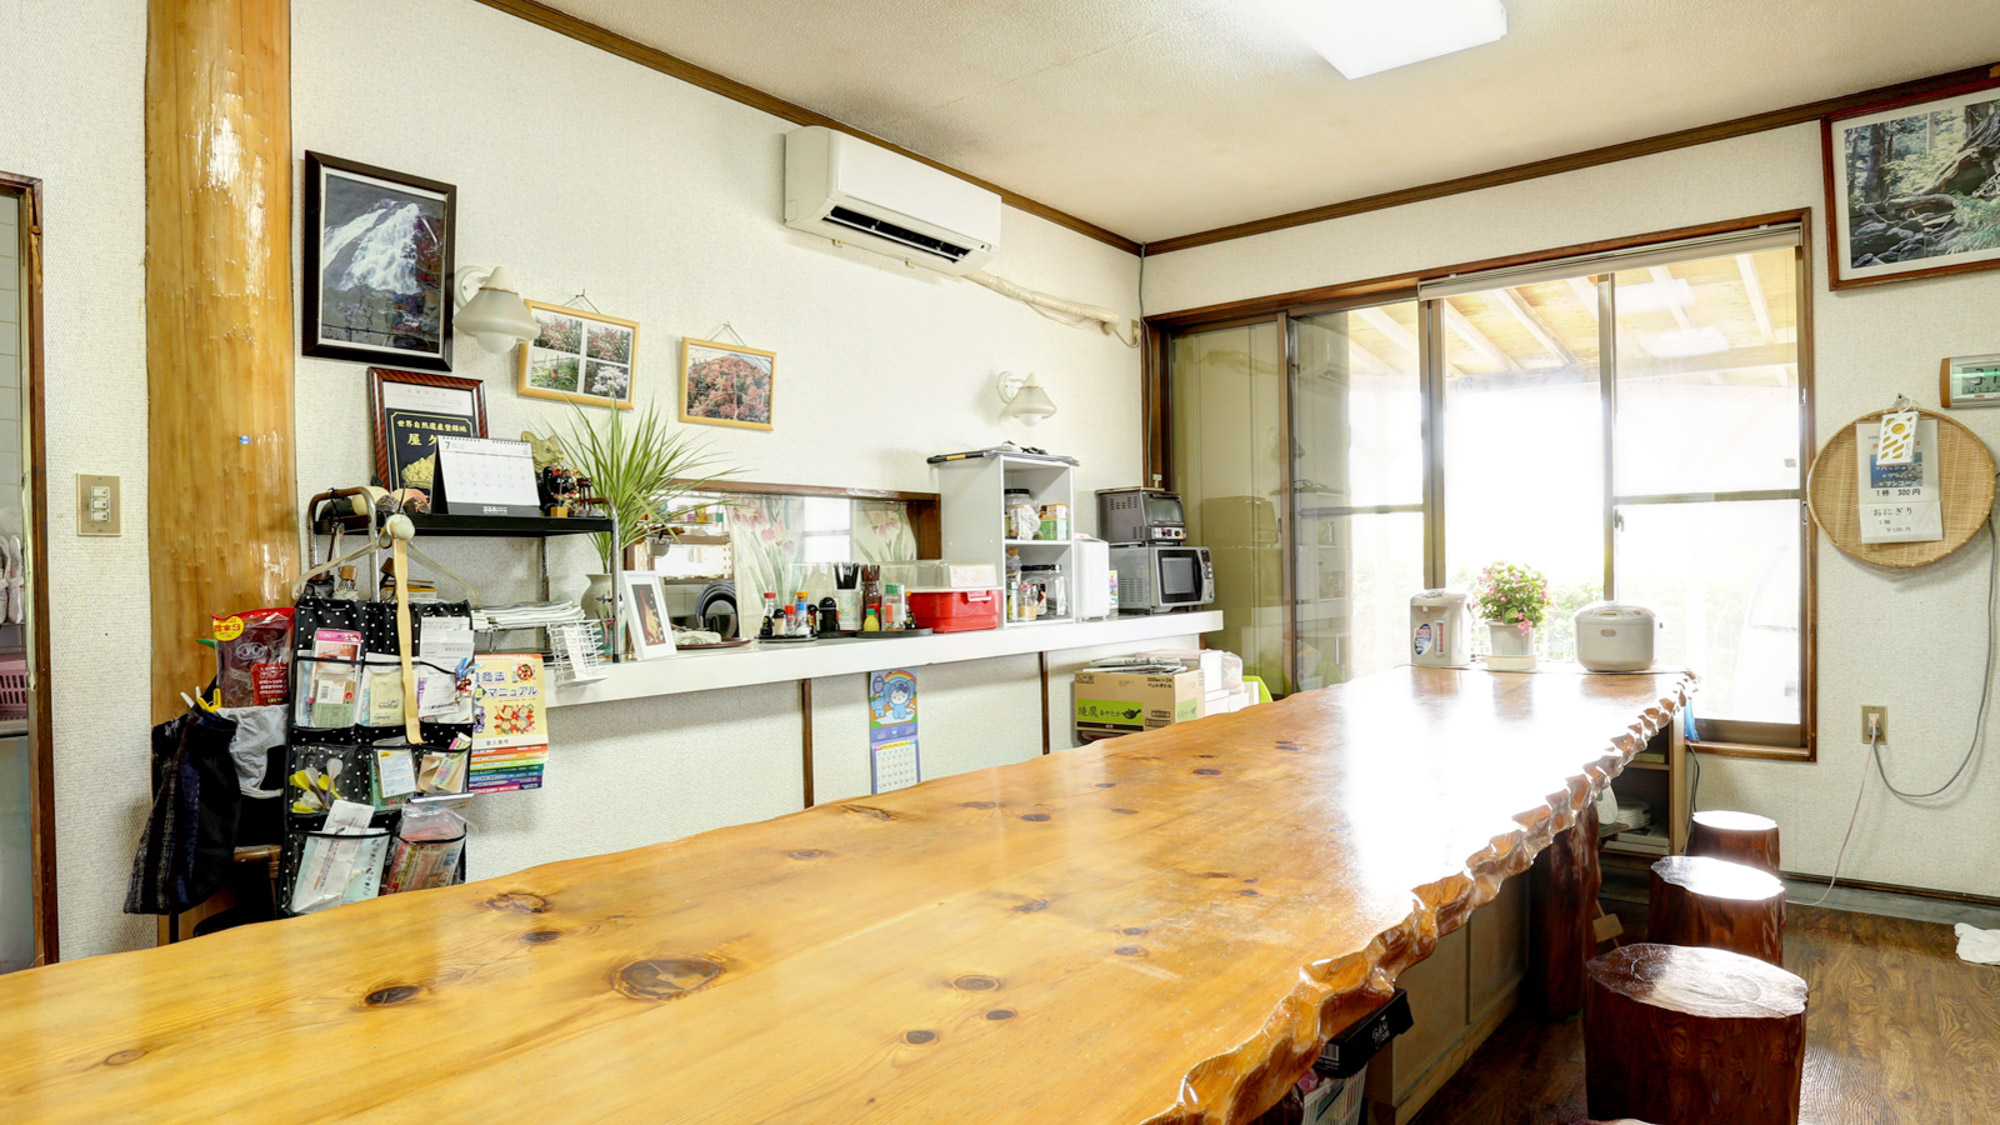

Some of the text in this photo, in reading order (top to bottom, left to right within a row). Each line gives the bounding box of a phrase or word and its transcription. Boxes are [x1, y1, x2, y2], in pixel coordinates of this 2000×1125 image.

[444, 441, 451, 449] 7
[1873, 506, 1913, 516] おにぎり
[488, 685, 538, 697] マニュアル
